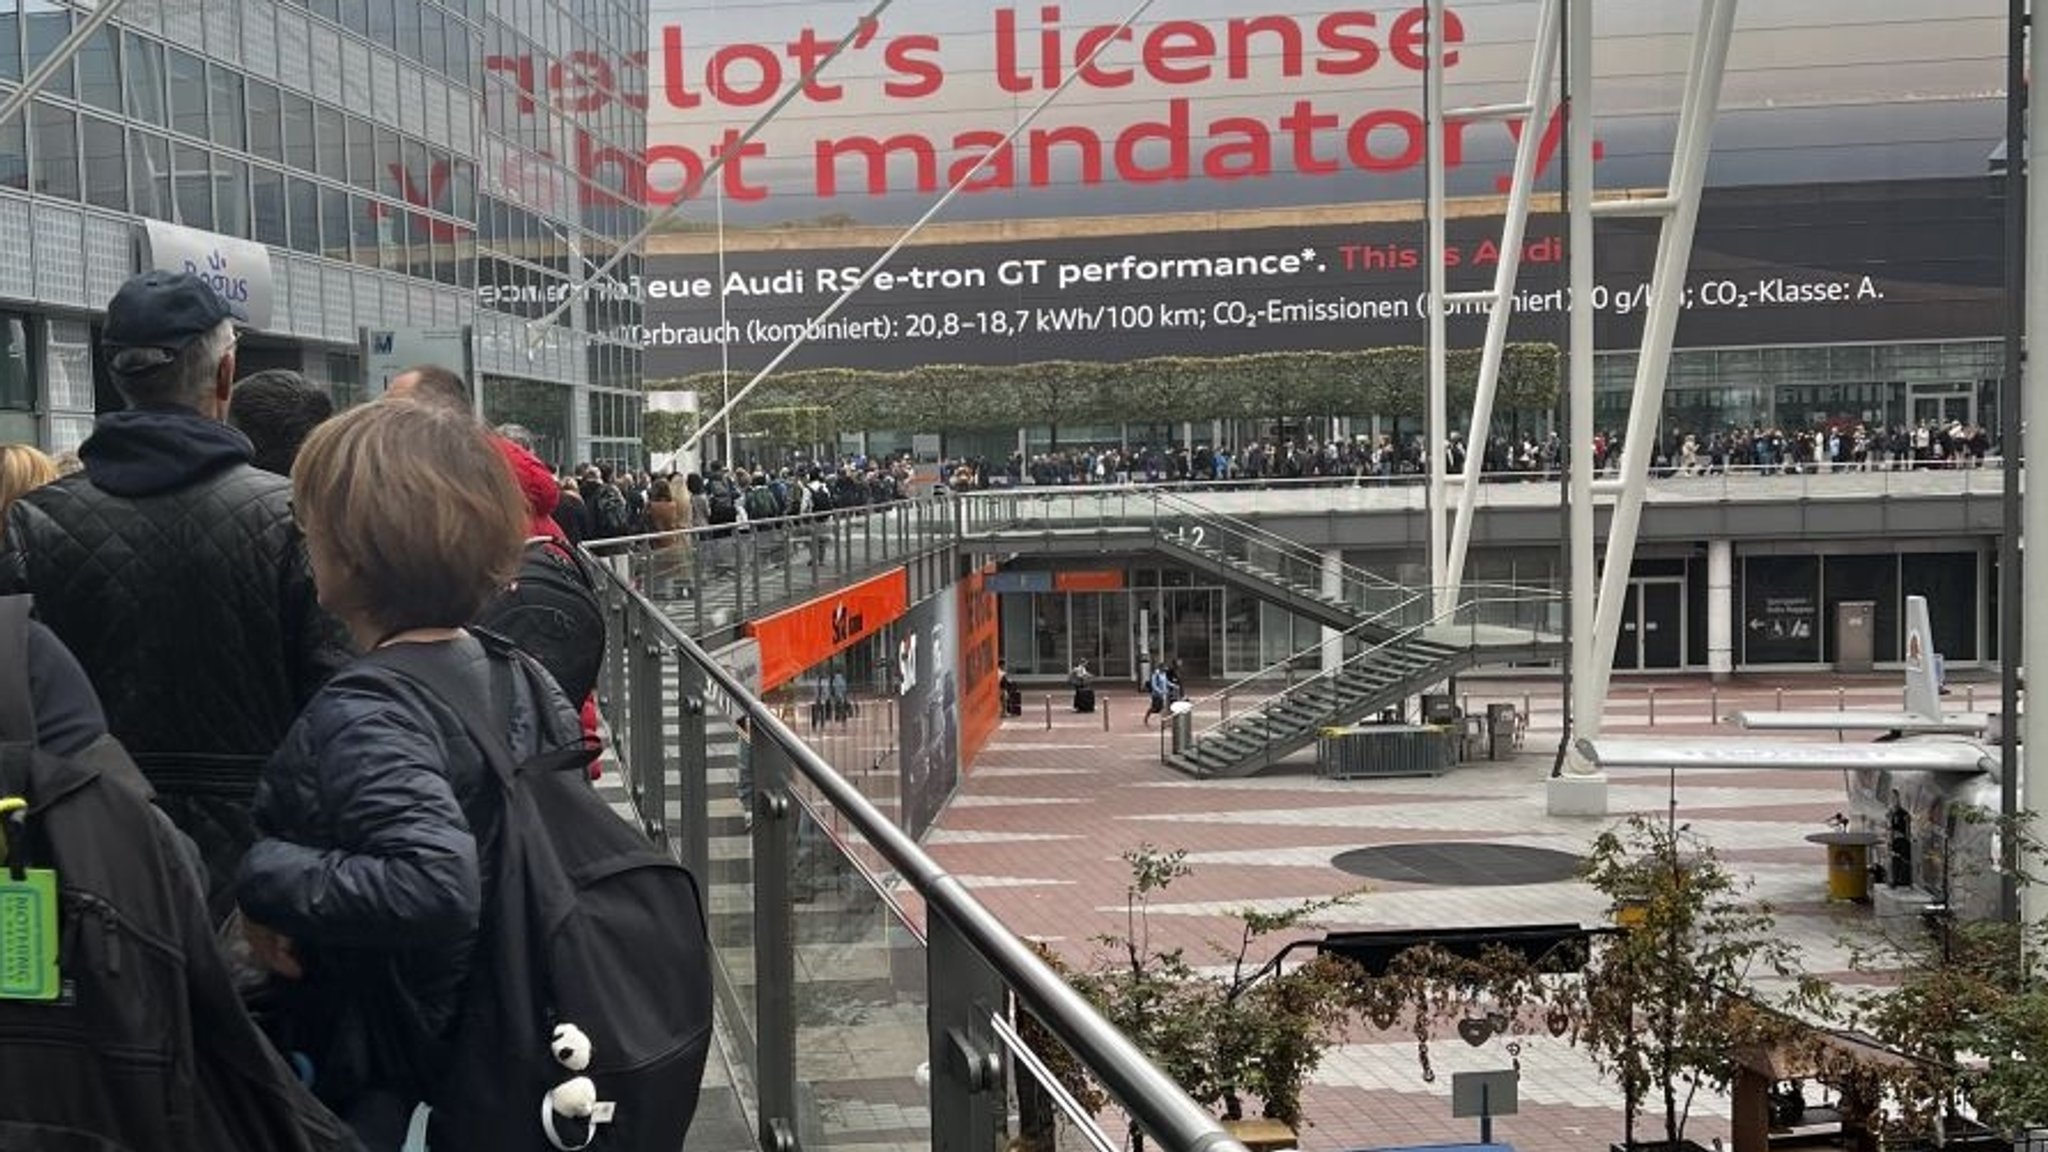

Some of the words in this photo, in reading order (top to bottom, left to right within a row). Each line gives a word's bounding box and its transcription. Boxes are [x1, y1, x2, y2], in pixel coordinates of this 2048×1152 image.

[997, 5, 1463, 92] license
[816, 97, 1604, 200] mandatory.
[723, 269, 803, 296] Audi
[817, 268, 861, 292] RS
[873, 264, 985, 291] e-tron
[997, 260, 1046, 285] GT
[1340, 245, 1417, 269] This
[1473, 238, 1562, 265] Adi
[747, 317, 898, 343] (kombiniert):
[1036, 305, 1153, 331] kWh/100
[1161, 302, 1205, 330] km;
[1615, 281, 1693, 313] g/;
[1857, 275, 1884, 299] A.
